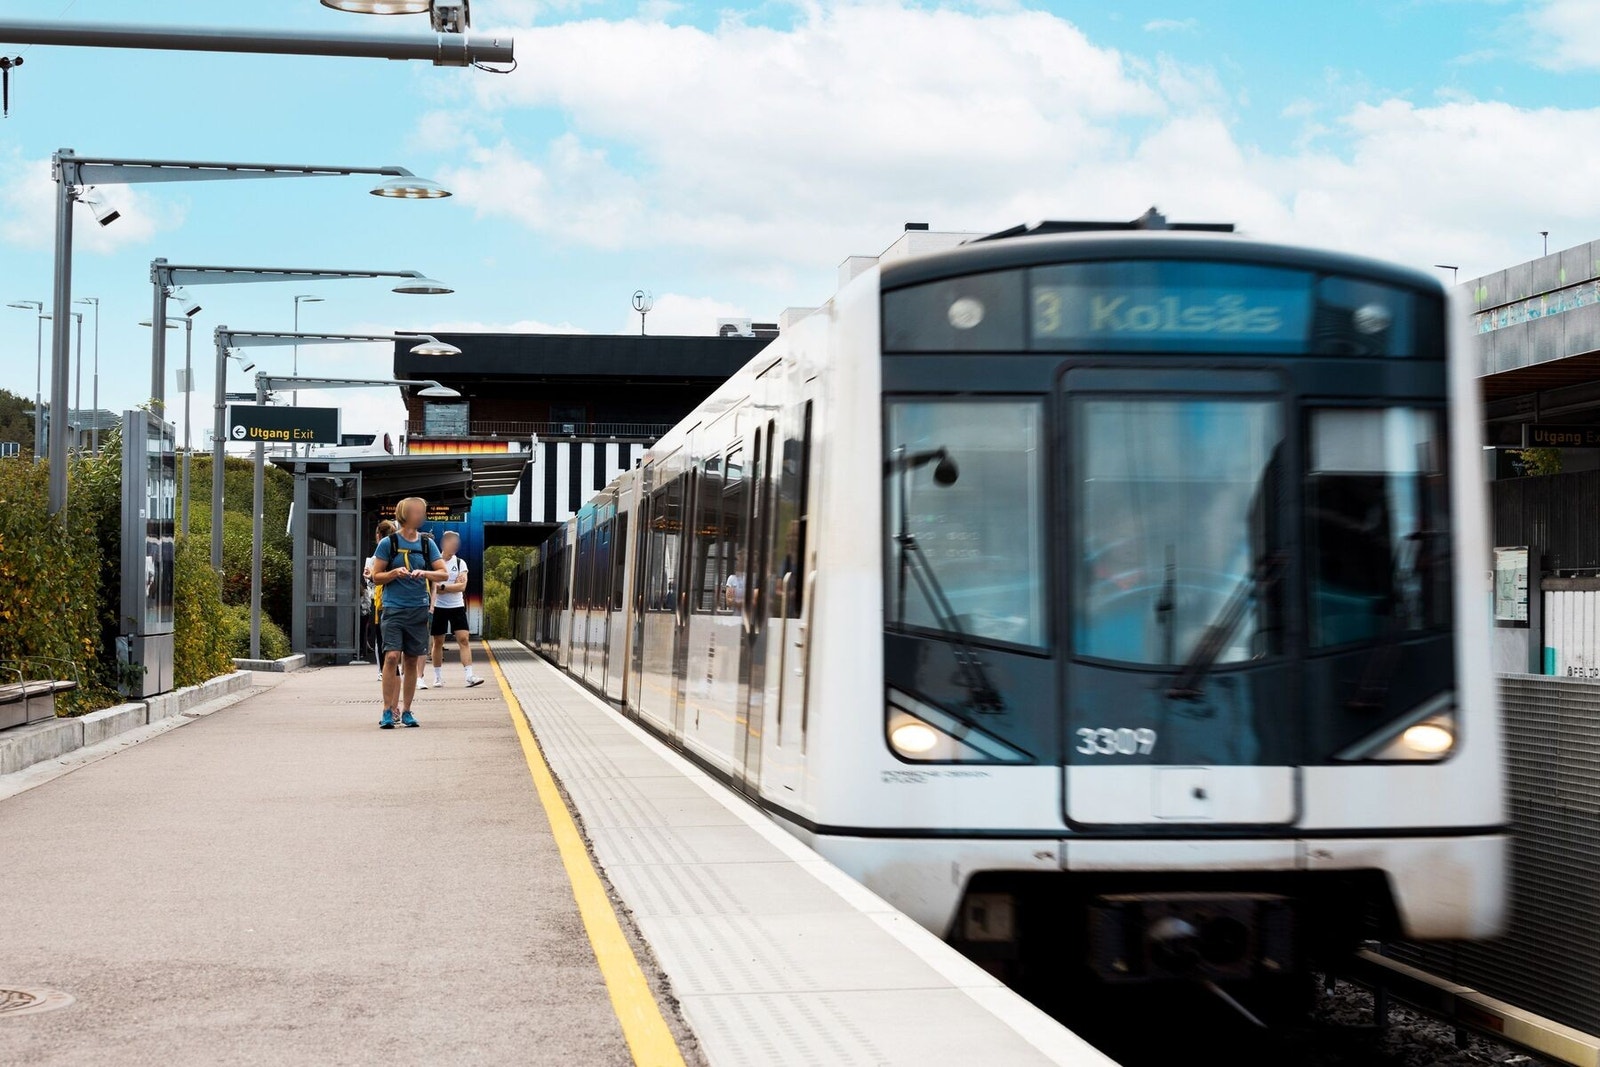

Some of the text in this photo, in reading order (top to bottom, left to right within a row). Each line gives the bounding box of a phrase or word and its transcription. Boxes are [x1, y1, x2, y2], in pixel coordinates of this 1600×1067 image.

[1034, 290, 1282, 334] 3 Kolsås
[249, 427, 314, 441] Utgang Exit
[1534, 429, 1582, 445] Utgang
[1076, 727, 1156, 755] 3309
